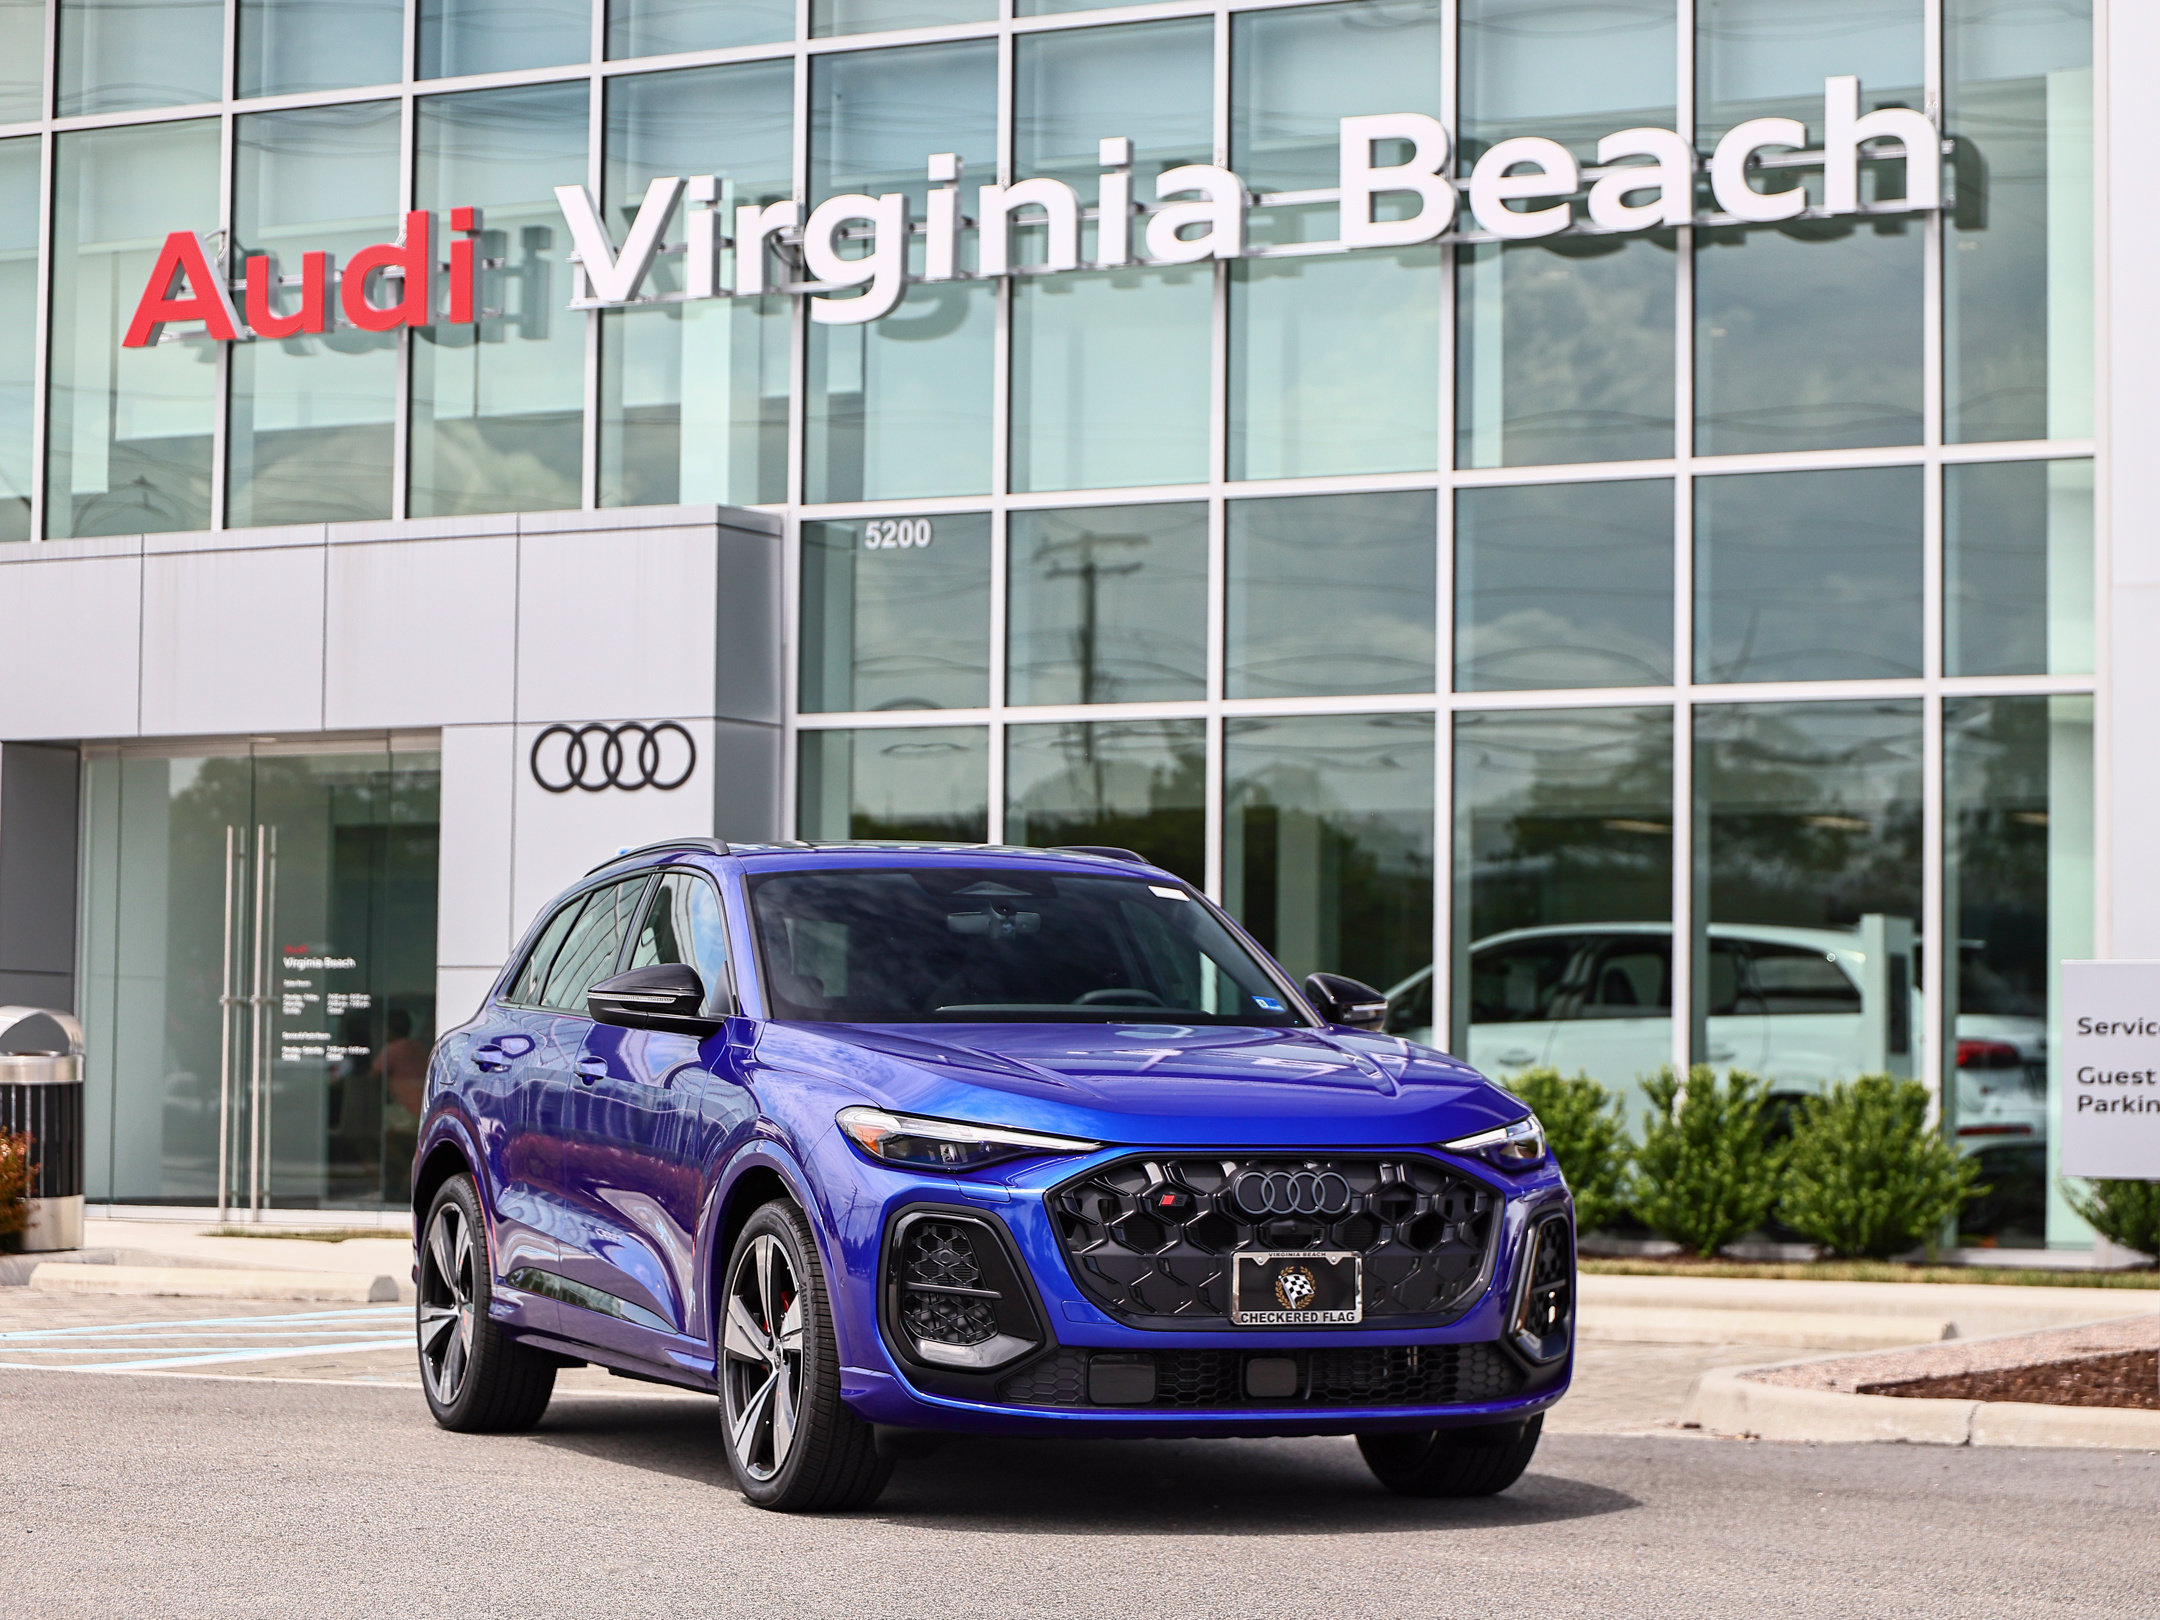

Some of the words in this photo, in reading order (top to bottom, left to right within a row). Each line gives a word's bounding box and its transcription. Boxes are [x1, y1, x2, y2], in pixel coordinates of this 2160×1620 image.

[122, 205, 484, 348] Audi
[554, 136, 1248, 325] Virginia
[1339, 74, 1942, 249] Beach
[864, 518, 932, 551] 5200
[2077, 1016, 2160, 1036] Servic
[2077, 1066, 2156, 1085] Guest
[1240, 1312, 1318, 1323] CHECKERED
[1322, 1311, 1355, 1322] FLAG
